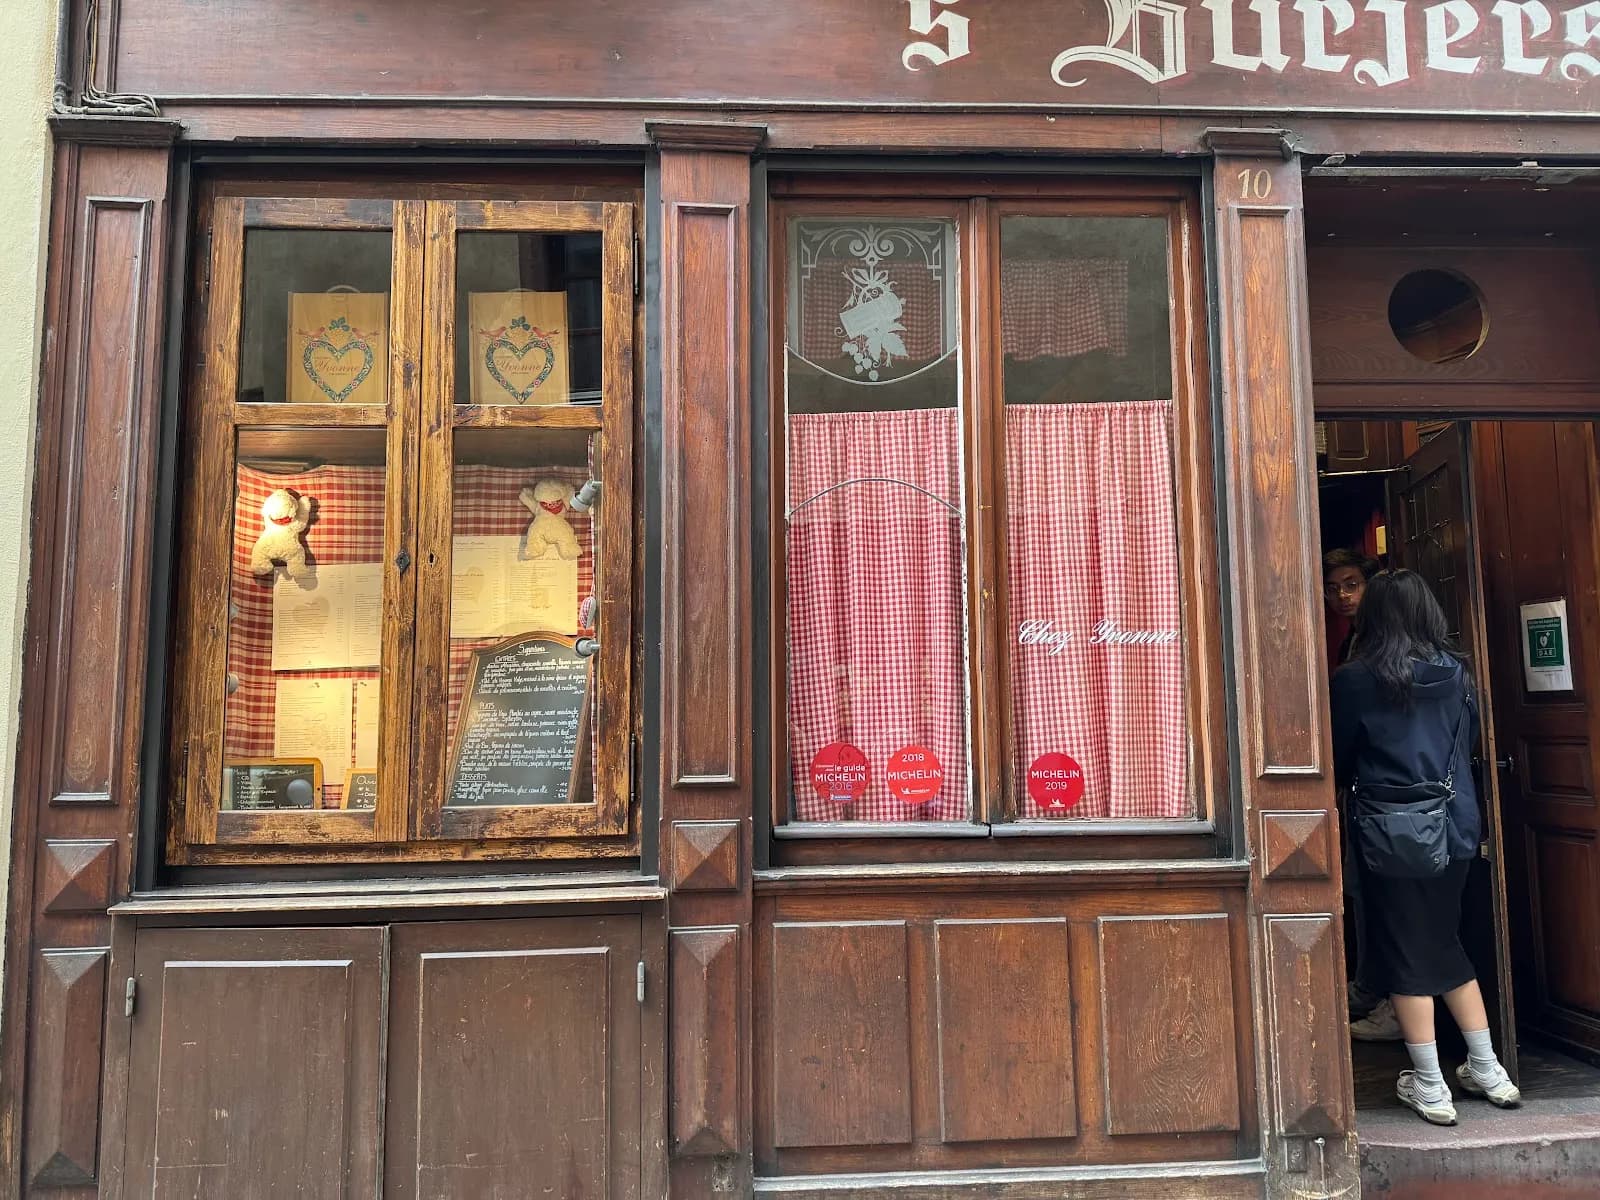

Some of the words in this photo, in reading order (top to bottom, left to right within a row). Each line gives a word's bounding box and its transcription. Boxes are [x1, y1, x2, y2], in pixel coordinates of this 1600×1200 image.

[1237, 168, 1272, 199] 10
[1018, 619, 1073, 656] Chez
[901, 753, 925, 762] 2018
[834, 764, 842, 772] le
[843, 764, 866, 773] guide
[815, 773, 867, 782] MICHELIN
[887, 769, 941, 780] MICHELIN
[1031, 769, 1080, 779] MICHELIN
[829, 782, 853, 790] 2016
[1045, 781, 1068, 790] 2019
